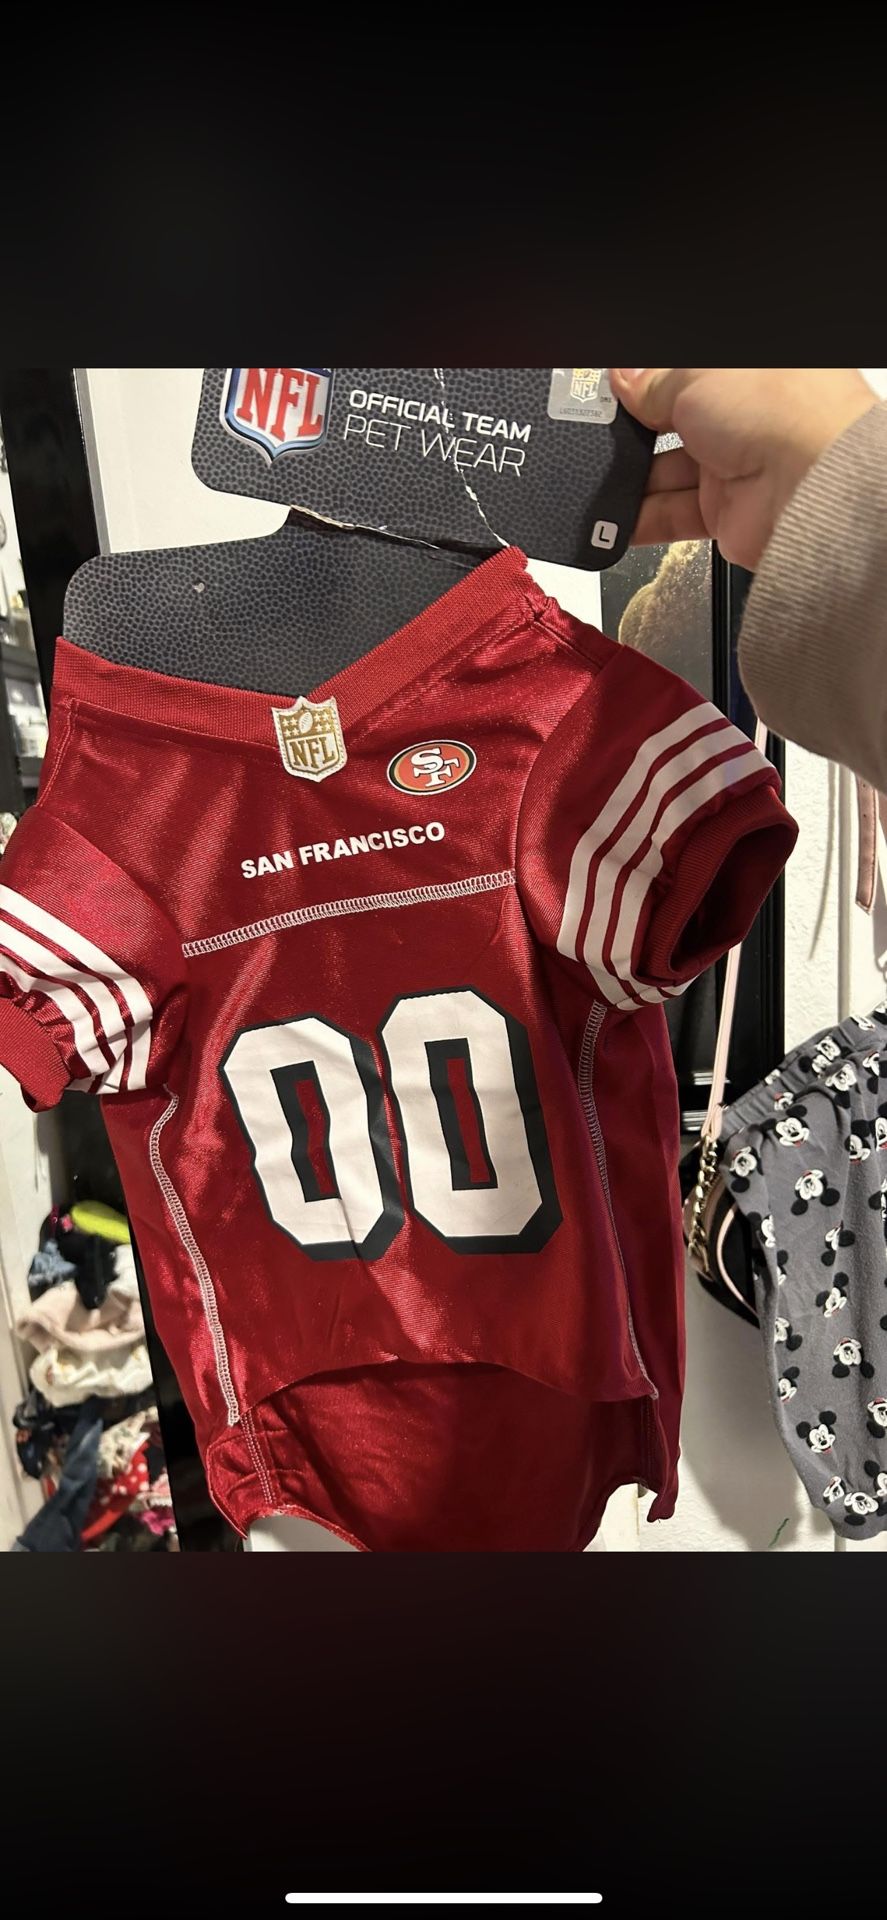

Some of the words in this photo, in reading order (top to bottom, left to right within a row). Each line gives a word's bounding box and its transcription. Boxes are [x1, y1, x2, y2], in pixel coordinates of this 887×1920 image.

[236, 368, 323, 442] NFL
[349, 389, 455, 429] OFFICIAL
[462, 411, 532, 443] TEAM
[572, 380, 598, 398] NFL
[343, 413, 412, 451] PET
[421, 428, 526, 477] WEAR
[598, 525, 611, 543] L
[289, 736, 336, 769] NFL
[241, 850, 294, 879] SAN
[298, 821, 446, 866] FRANCISCO
[218, 984, 563, 1261] 00
